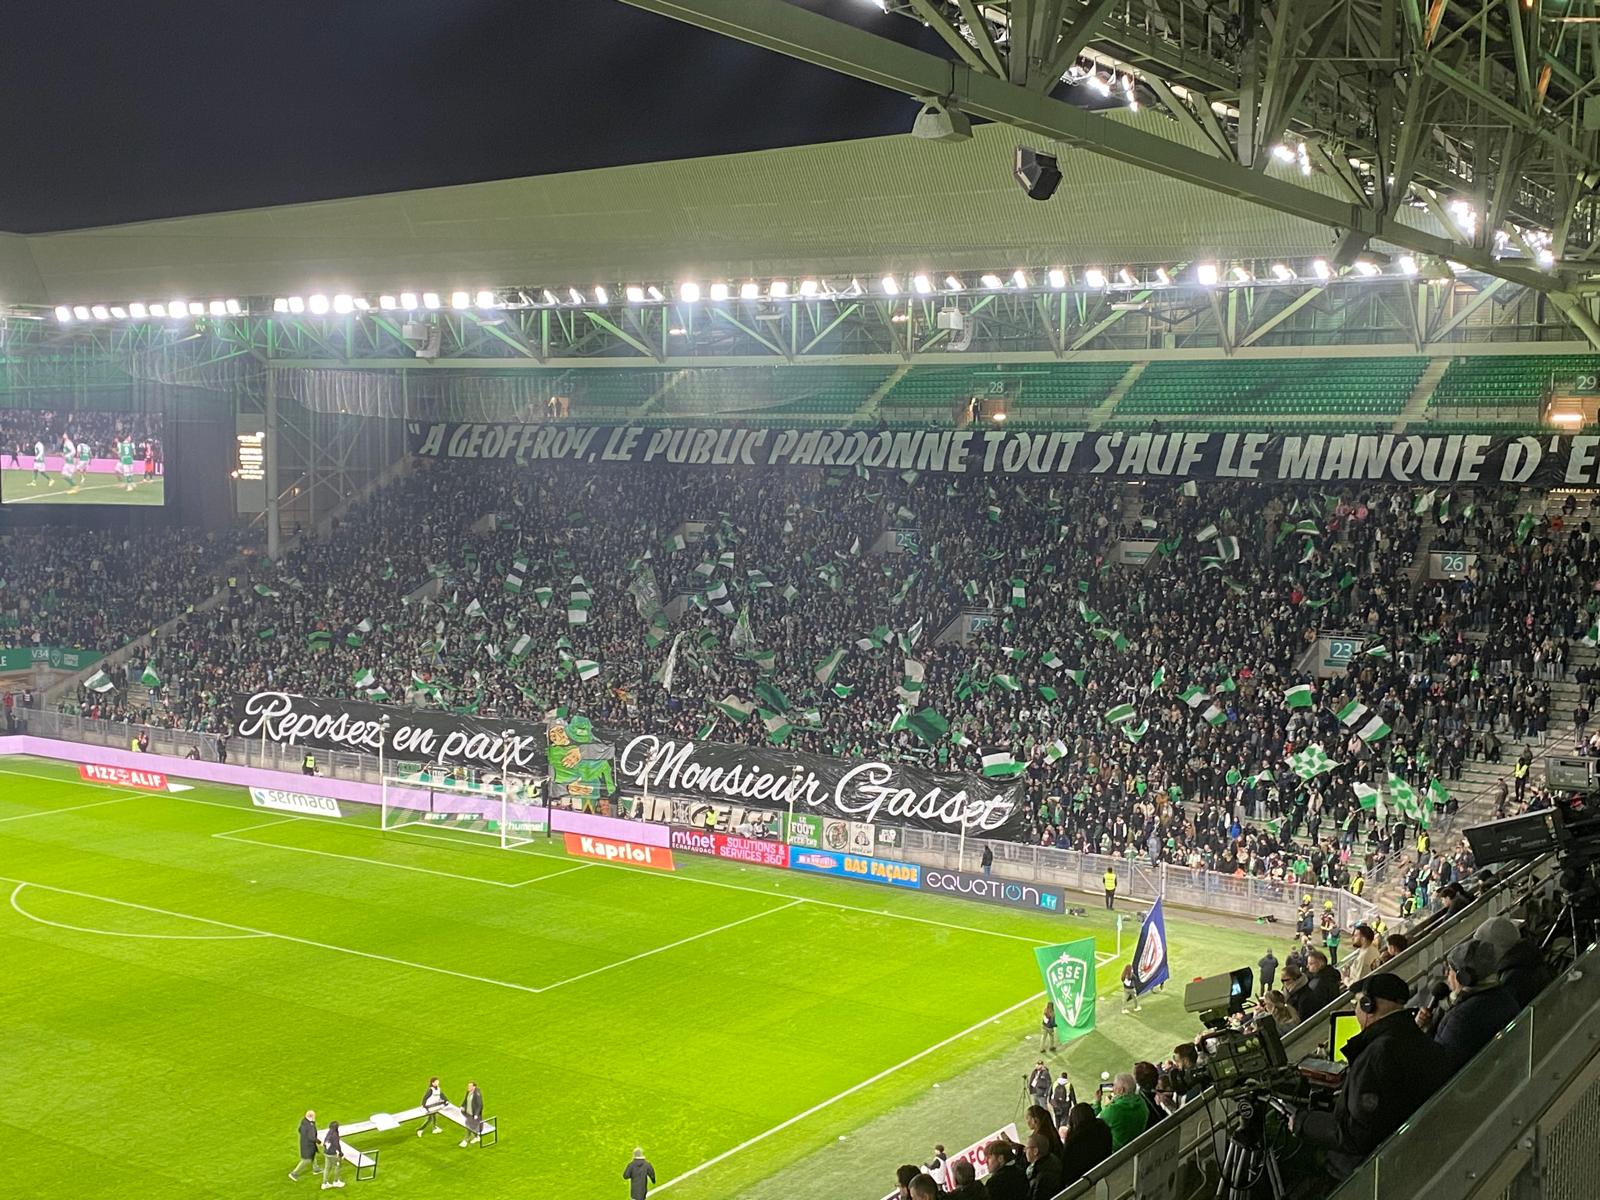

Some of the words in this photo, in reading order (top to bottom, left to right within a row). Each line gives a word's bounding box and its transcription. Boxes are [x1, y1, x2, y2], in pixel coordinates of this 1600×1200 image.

[990, 381, 1004, 394] 28
[1577, 375, 1597, 390] 29
[448, 424, 600, 464] GEOFFROY,
[601, 427, 644, 461] LE
[643, 428, 768, 465] PUBLIC
[768, 429, 974, 473] PARDONNE
[983, 431, 1085, 473] TOUT
[1215, 432, 1269, 478] LE
[1277, 433, 1492, 481] MANQUE
[1443, 556, 1464, 571] 26
[1332, 642, 1352, 658] 23
[239, 691, 385, 748] Reposez
[392, 724, 437, 753] en
[437, 729, 535, 766] paix
[620, 735, 829, 807] Monsieur
[835, 761, 1015, 830] Gasset
[269, 789, 337, 812] sermaco
[791, 821, 816, 836] FOOT
[580, 837, 652, 864] Kapriol
[720, 847, 762, 861] SERVICES
[726, 837, 777, 852] SOLUTIONS
[777, 844, 786, 855] &
[1051, 965, 1082, 985] ASSE
